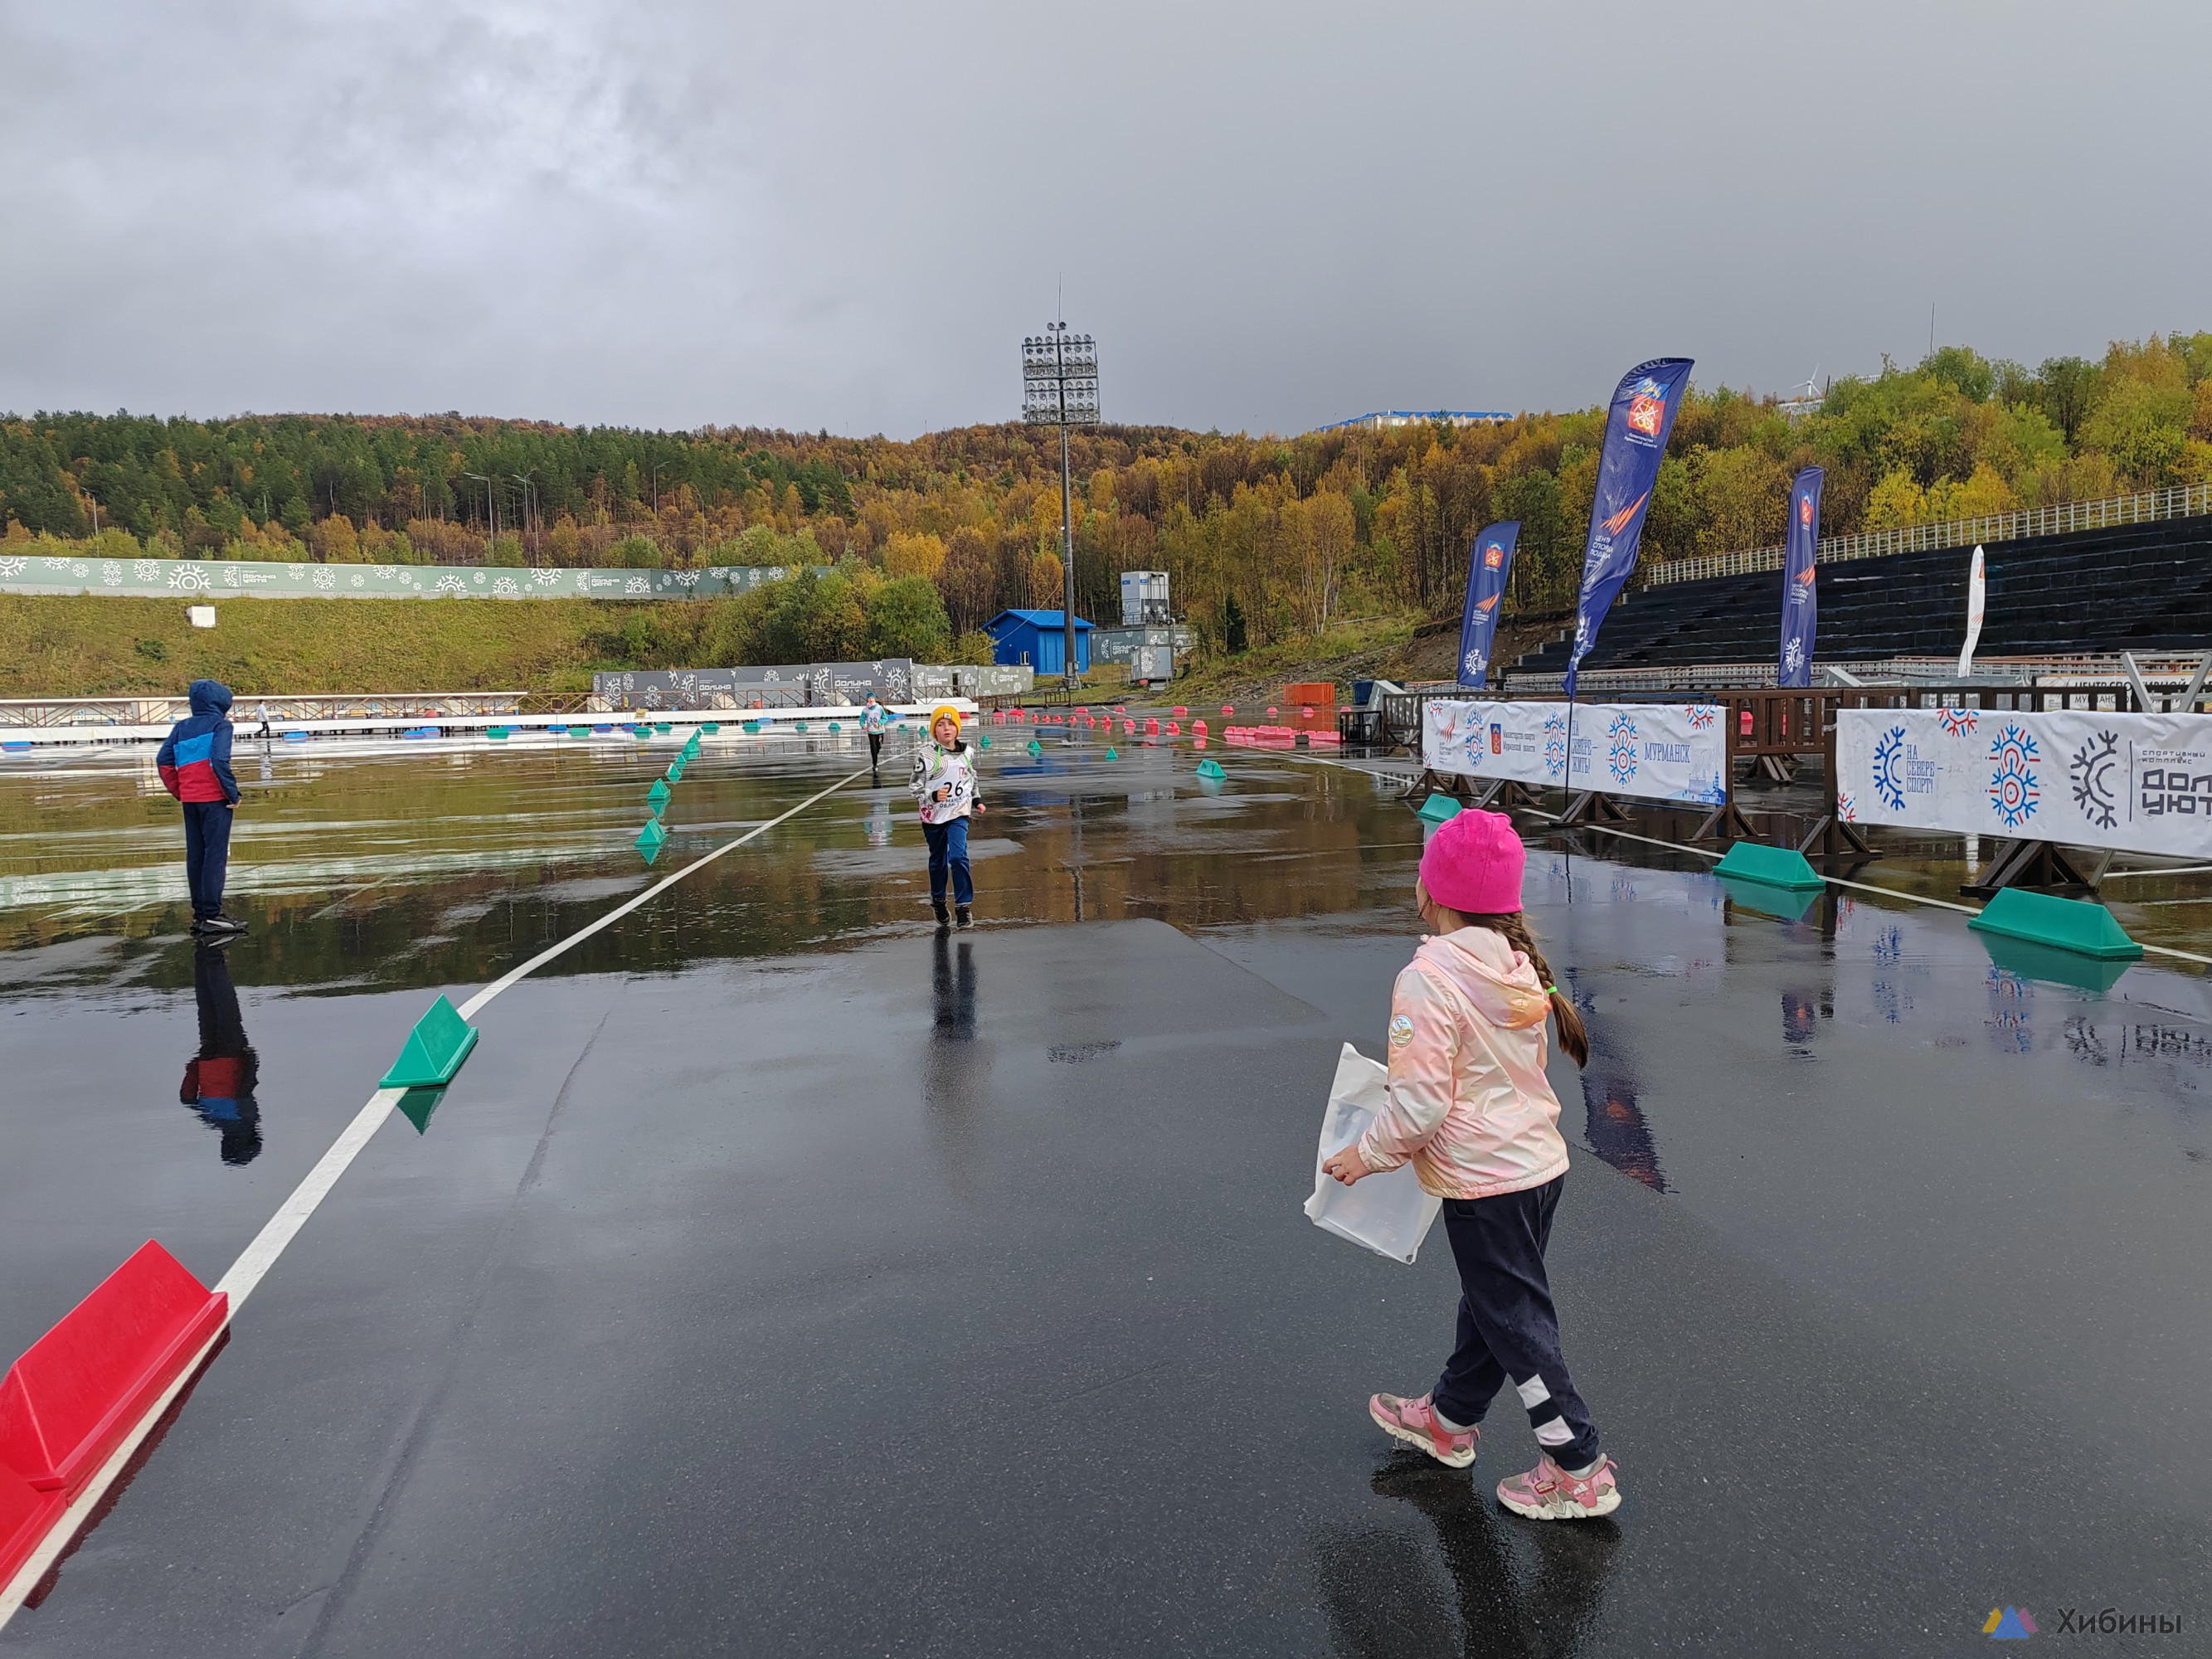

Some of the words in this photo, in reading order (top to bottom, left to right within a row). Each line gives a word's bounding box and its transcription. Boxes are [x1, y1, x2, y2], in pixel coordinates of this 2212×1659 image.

[1572, 720, 1579, 736] НА
[1644, 742, 1690, 763] МУРМАНСК
[1906, 744, 1918, 760] НА
[1906, 760, 1935, 777] СЕВЕРЕ
[944, 781, 964, 798] 26
[1906, 776, 1933, 794] СПОРТ!
